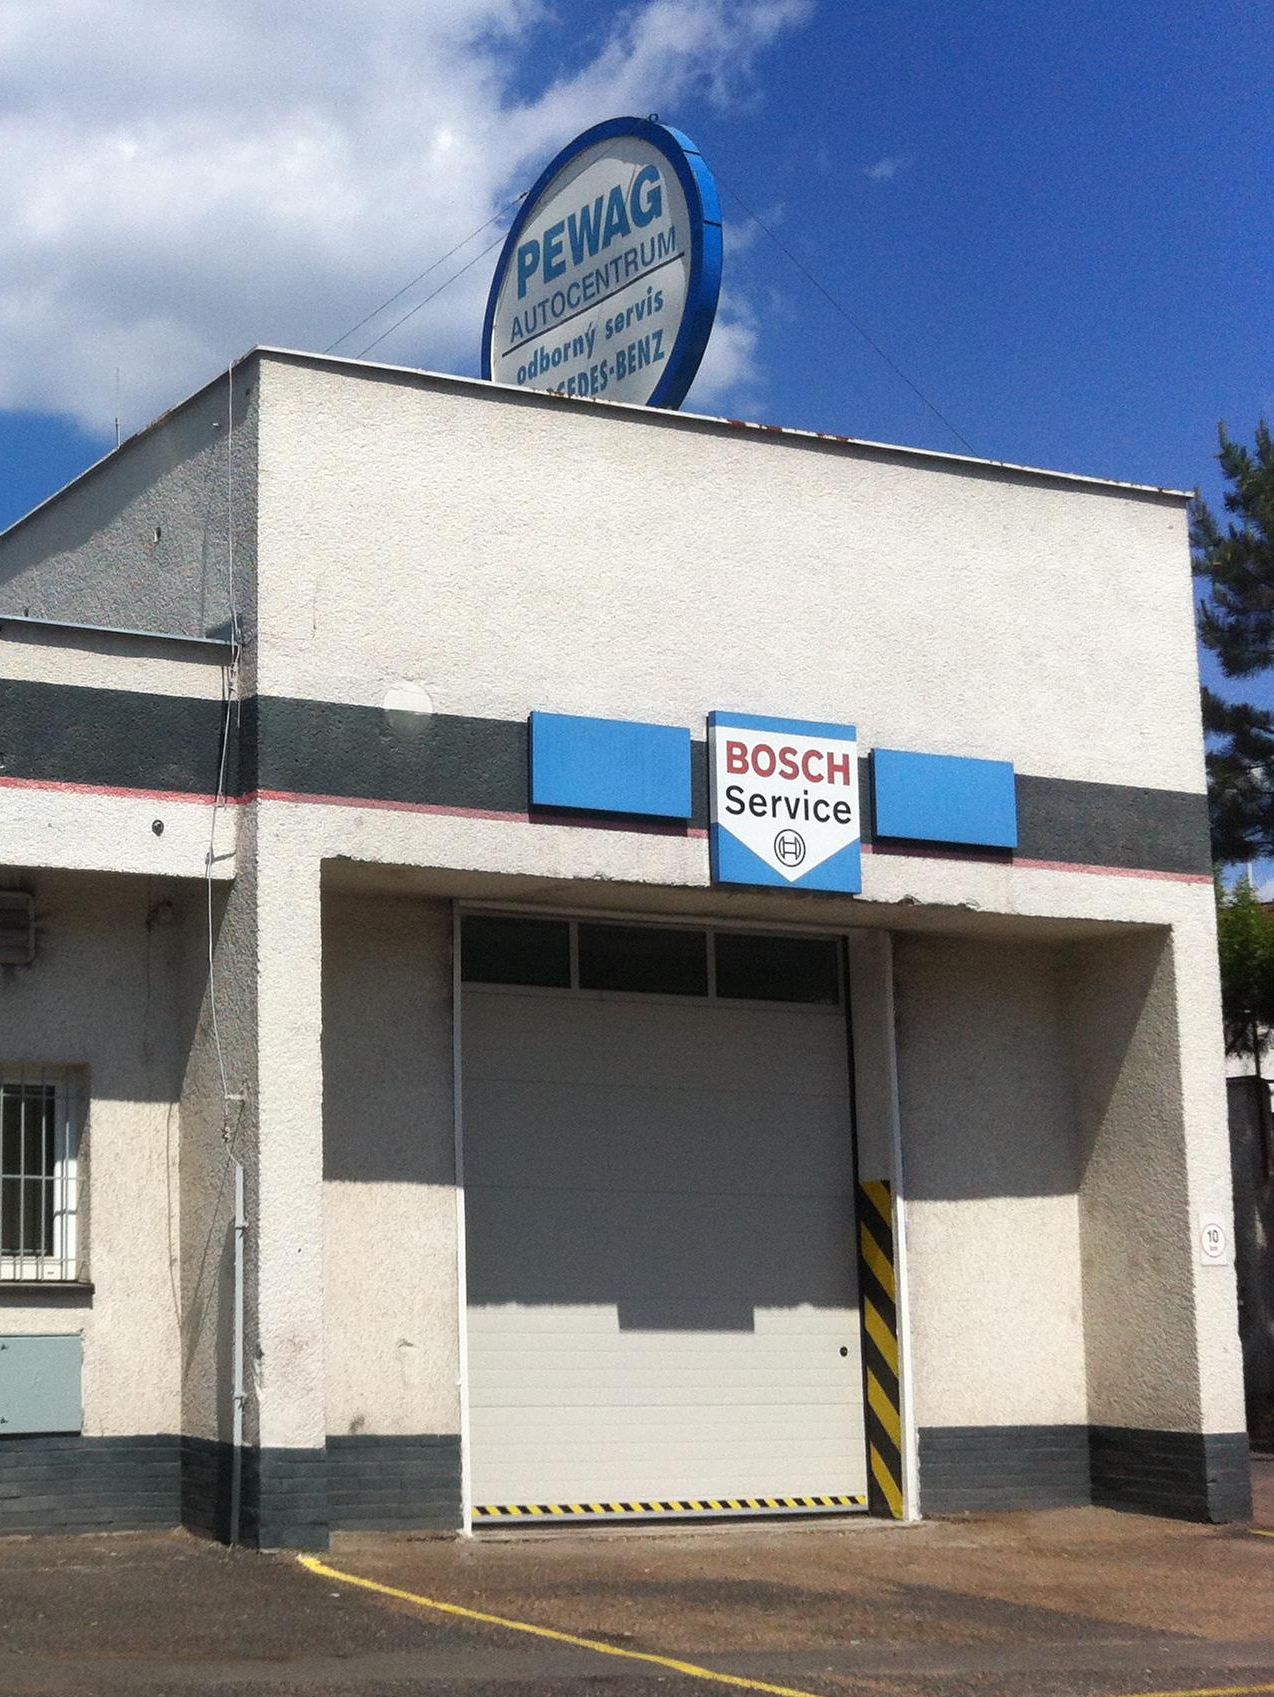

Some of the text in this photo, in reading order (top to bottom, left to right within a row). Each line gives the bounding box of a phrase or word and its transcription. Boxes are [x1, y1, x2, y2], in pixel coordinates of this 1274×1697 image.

[516, 163, 663, 300] PEWAG
[511, 225, 677, 344] AUTOCENTRUM
[517, 285, 665, 386] odborný servis
[726, 740, 851, 786] BOSCH
[725, 785, 852, 825] Service
[1206, 1229, 1219, 1243] 10
